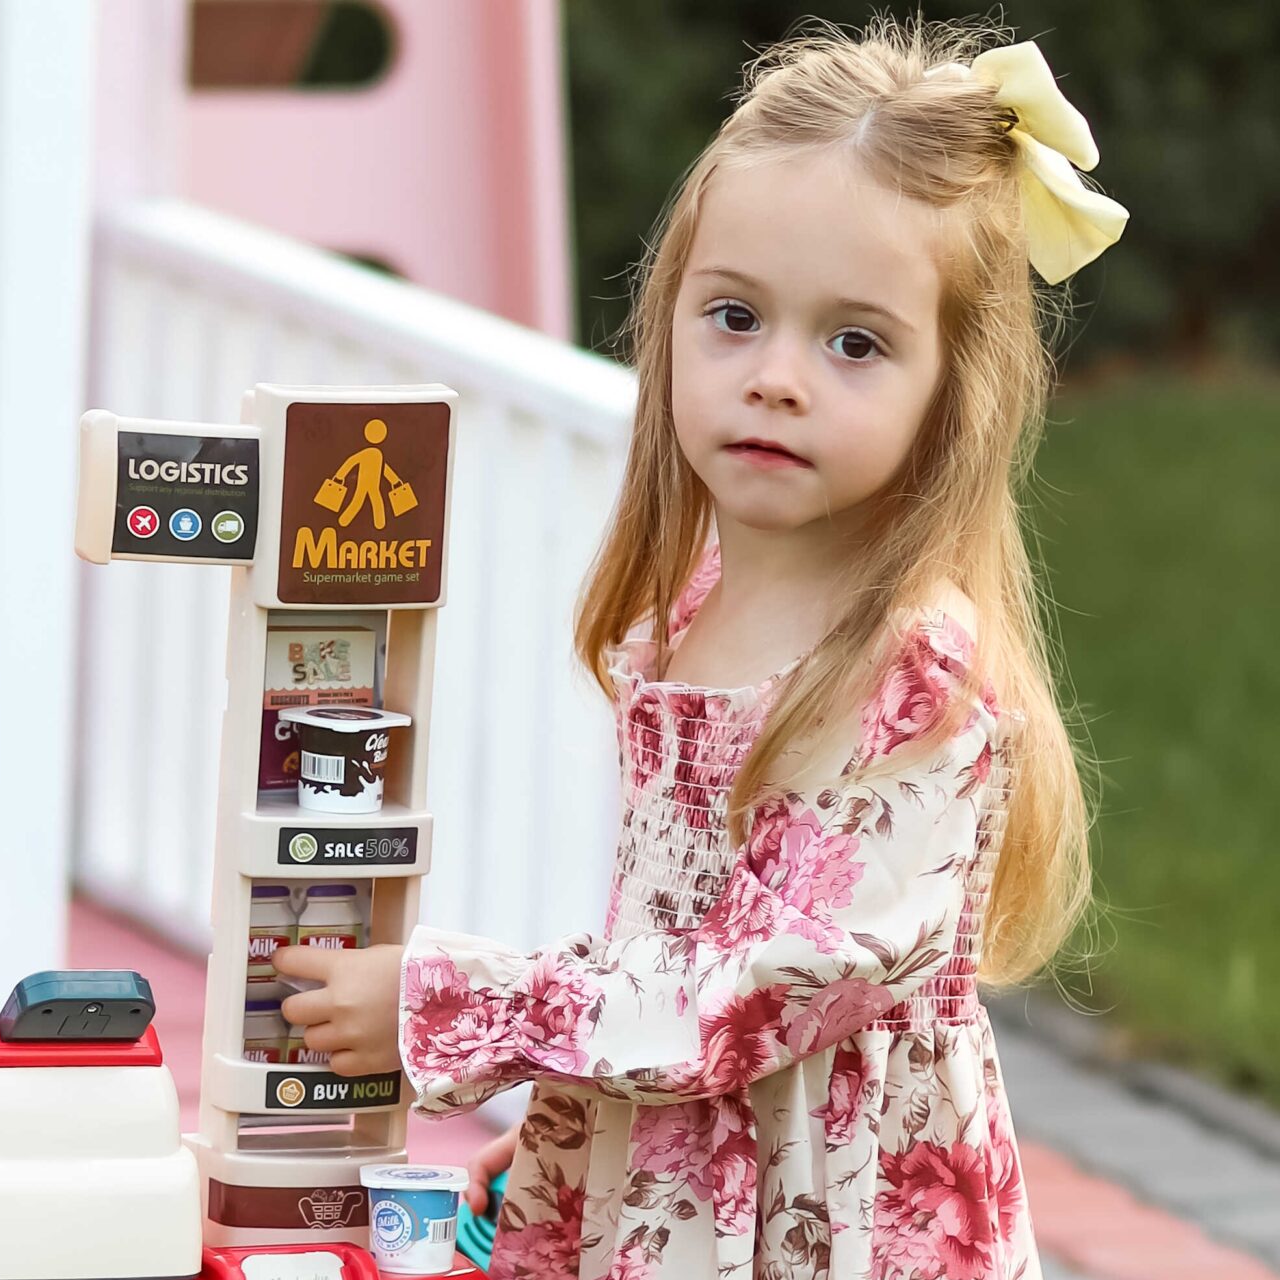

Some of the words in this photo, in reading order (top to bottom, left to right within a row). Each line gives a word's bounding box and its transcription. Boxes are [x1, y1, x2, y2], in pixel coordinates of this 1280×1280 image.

[128, 458, 249, 485] LOGISTICS
[292, 526, 432, 569] MARKET
[302, 571, 371, 584] Supermarket
[374, 574, 403, 586] game
[405, 572, 420, 583] set
[292, 660, 352, 685] SALE
[324, 842, 365, 858] SALE
[313, 1083, 349, 1101] BUY
[353, 1079, 394, 1098] NOW
